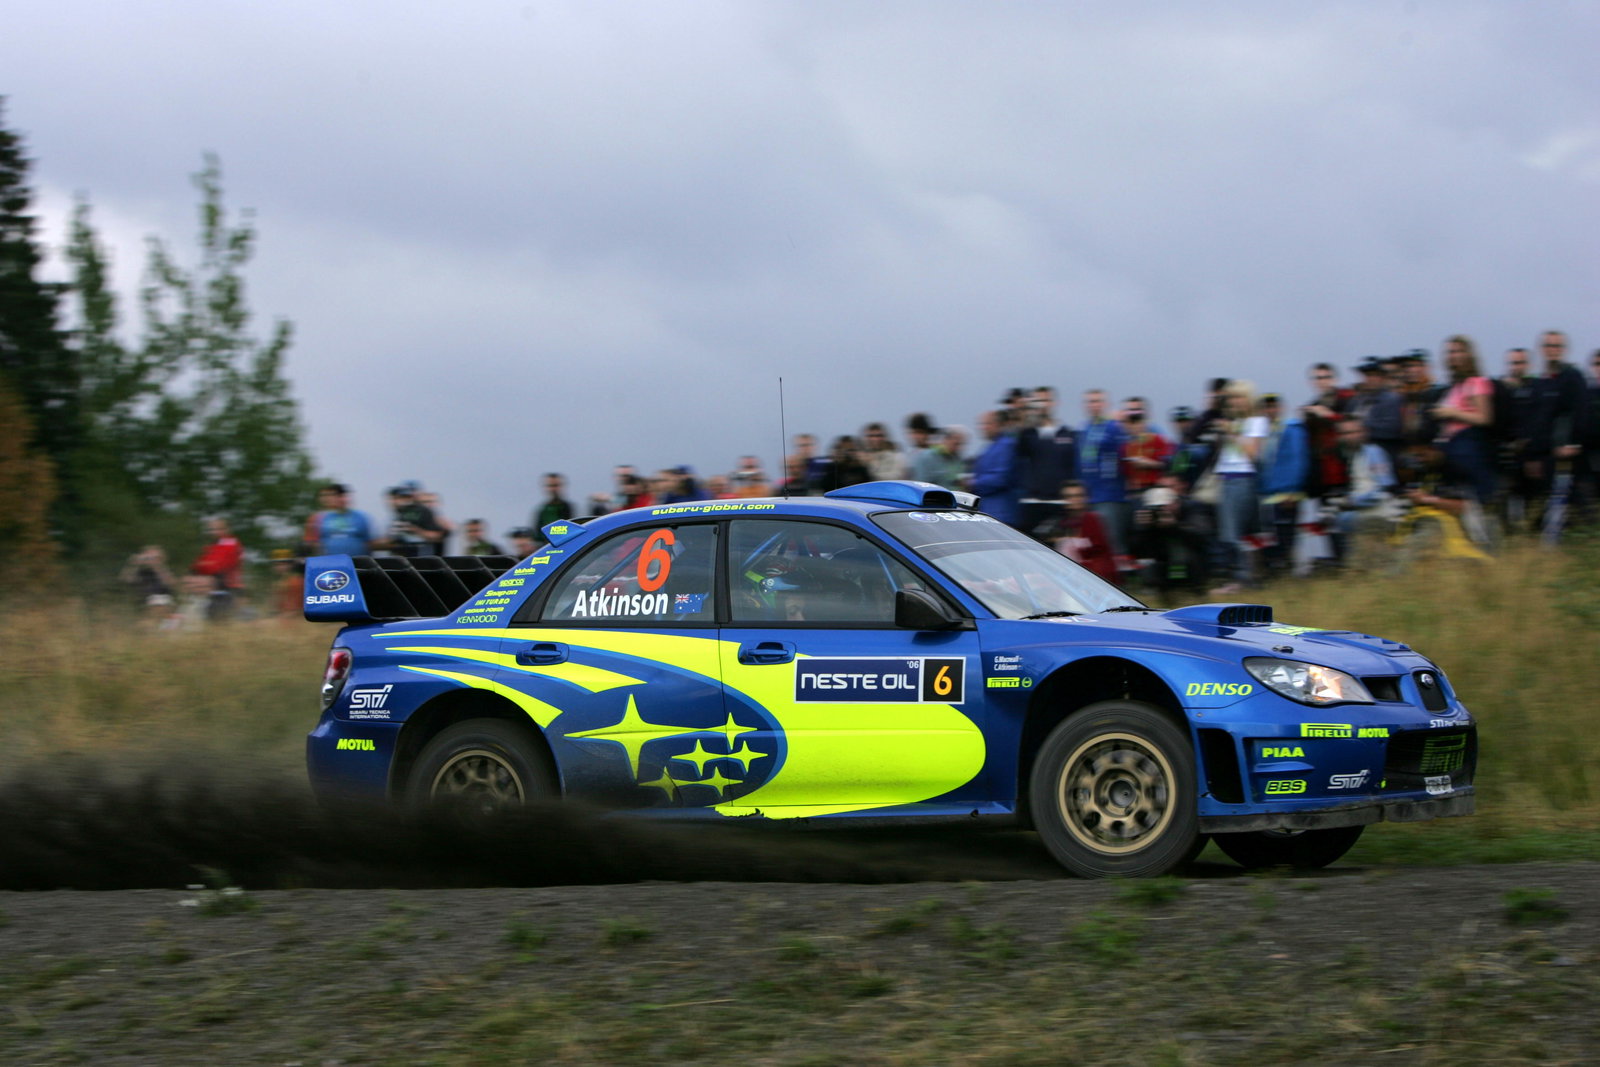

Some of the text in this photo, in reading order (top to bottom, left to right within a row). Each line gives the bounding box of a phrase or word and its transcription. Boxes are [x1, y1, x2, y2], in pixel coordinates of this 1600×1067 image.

[652, 504, 775, 515] subaru-global.com
[637, 529, 675, 592] 6
[306, 594, 354, 604] SUBARU
[571, 587, 668, 617] Atkinson
[456, 614, 498, 623] KENWOOD
[907, 661, 919, 669] '06
[801, 673, 916, 690] NESTE OIL
[933, 665, 953, 696] 6
[987, 677, 1020, 688] PIRELLI
[1185, 682, 1253, 696] DENSO
[1300, 723, 1352, 738] PIRELLI
[1357, 728, 1390, 738] MOTUL
[336, 738, 376, 751] MOTUL
[1262, 747, 1305, 758] PIAA
[1265, 779, 1307, 794] BBS
